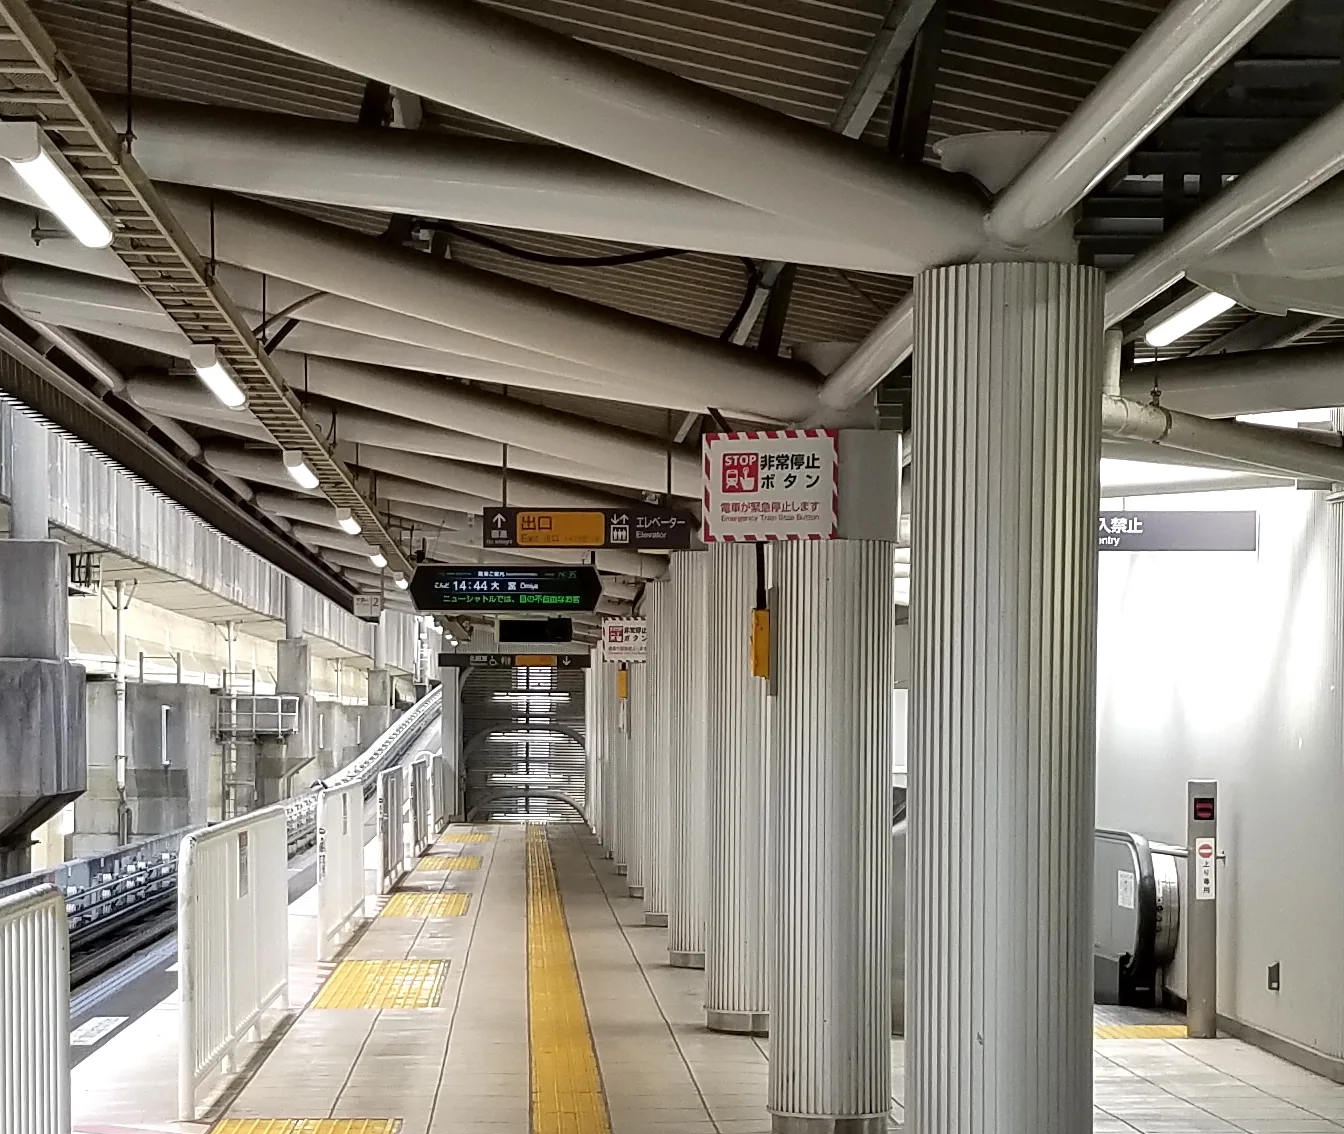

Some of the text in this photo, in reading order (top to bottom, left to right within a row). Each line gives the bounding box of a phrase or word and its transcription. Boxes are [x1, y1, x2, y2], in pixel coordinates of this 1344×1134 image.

[724, 455, 757, 466] STOP
[760, 453, 821, 471] 非常停止
[761, 473, 820, 489] ボタン
[720, 501, 820, 513] 電車が緊急停止します
[521, 515, 552, 531] 出口
[635, 516, 686, 529] エレベーター
[635, 531, 667, 540] Elevator
[453, 580, 488, 591] 14:44
